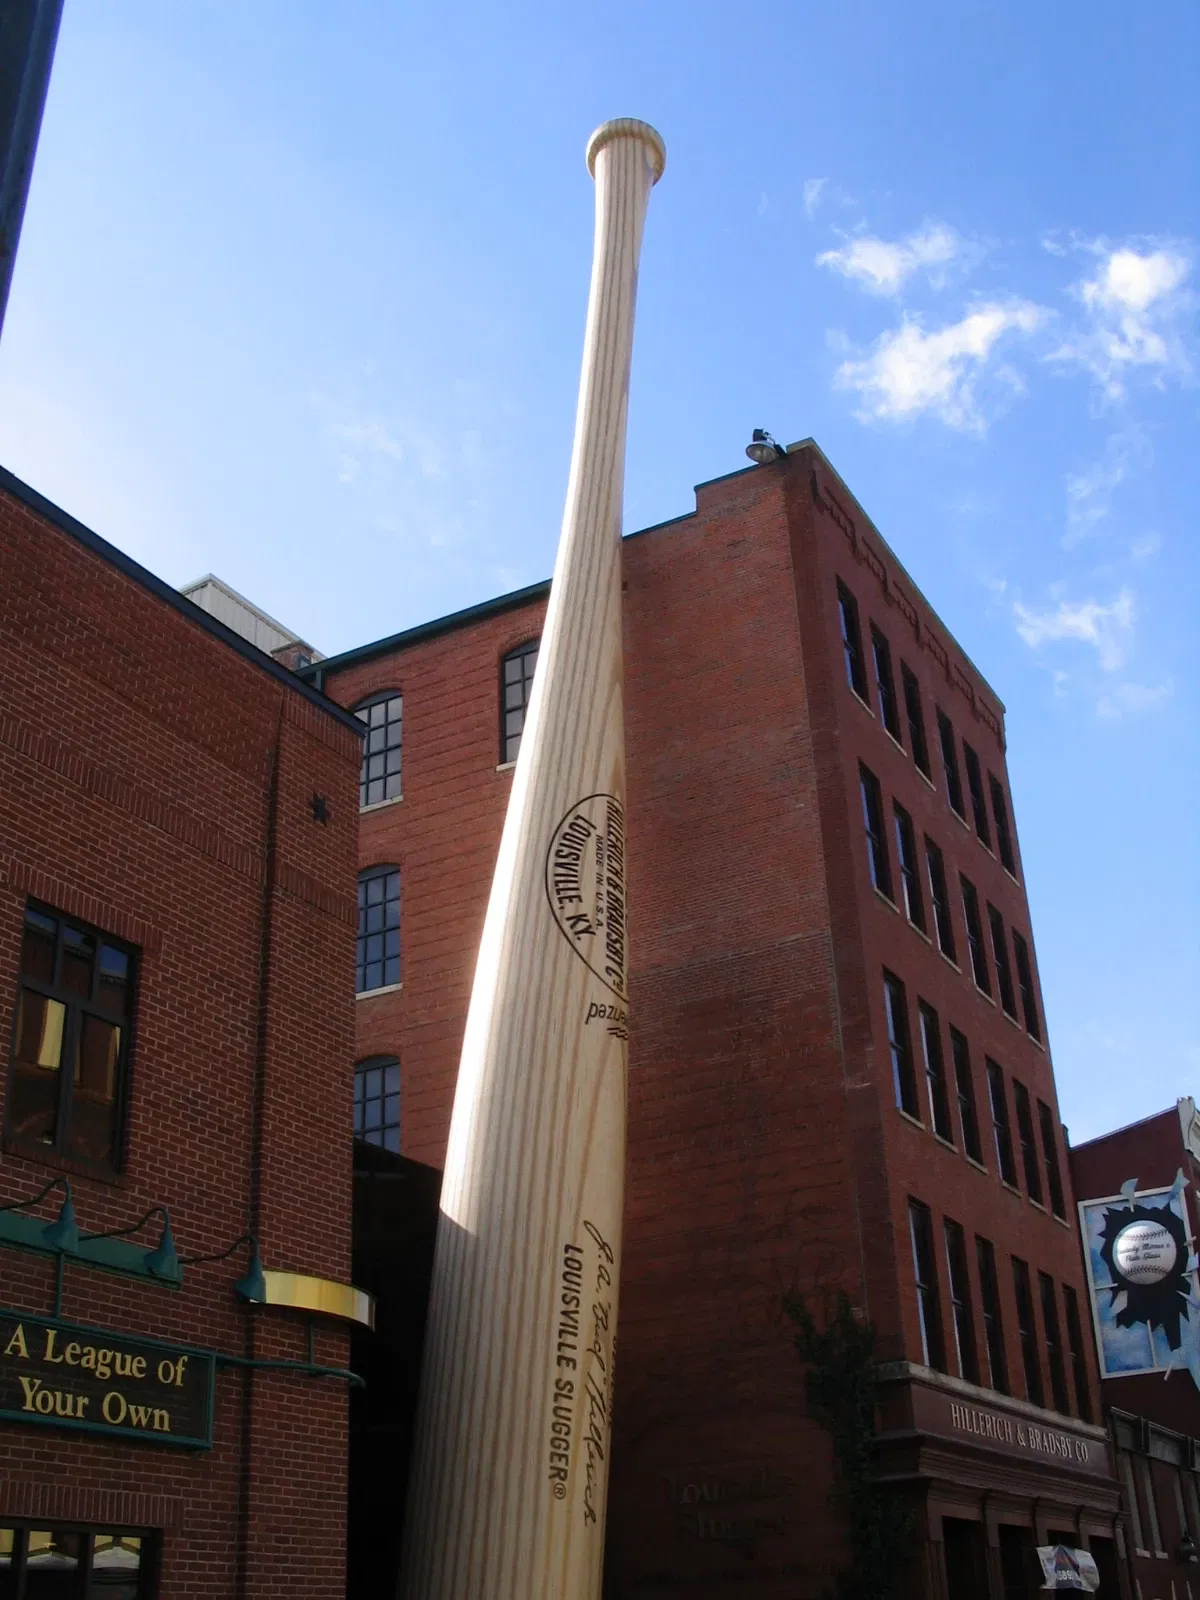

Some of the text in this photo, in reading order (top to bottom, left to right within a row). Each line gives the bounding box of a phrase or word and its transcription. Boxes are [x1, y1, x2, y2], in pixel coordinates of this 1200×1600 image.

[595, 834, 604, 867] MADE
[606, 800, 624, 884] HILLERICH
[595, 872, 604, 886] IN
[565, 913, 597, 941] KY.
[605, 890, 624, 972] BRADSBY
[556, 1243, 584, 1371] LOUISVILLE
[4, 1323, 188, 1387] A League of
[18, 1375, 171, 1432] Your Own
[950, 1403, 1013, 1443] HILLERICH
[1016, 1424, 1026, 1447] &
[1028, 1426, 1072, 1459] BRADSBY
